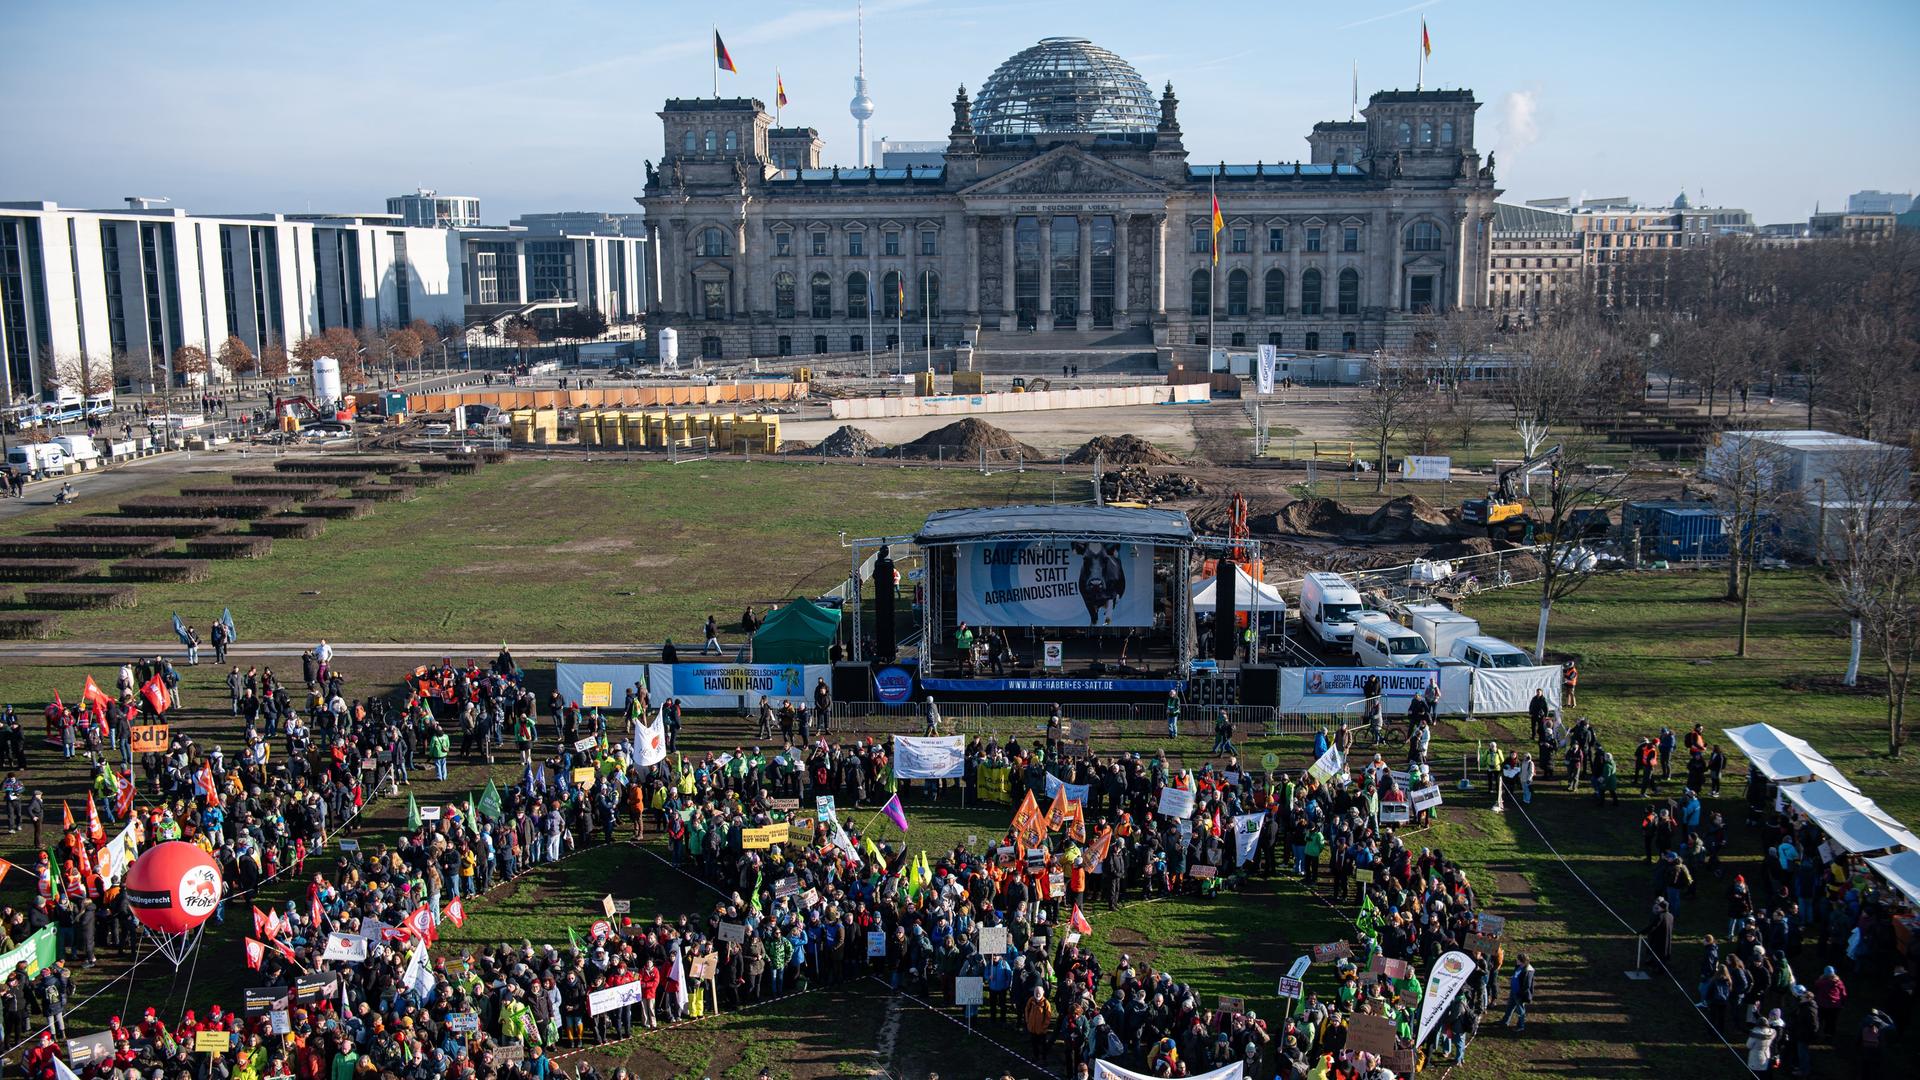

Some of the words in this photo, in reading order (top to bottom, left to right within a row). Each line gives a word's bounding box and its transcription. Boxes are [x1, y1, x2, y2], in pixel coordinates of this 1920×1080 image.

[983, 545, 1070, 566] BAUERNHÖFE
[1034, 567, 1068, 582] STATT
[985, 583, 1079, 605] AGRARINDUSTRIE!
[692, 667, 740, 677] LANDWIRTSCHAFT
[744, 667, 784, 677] GESELLSCHAFT
[1333, 674, 1352, 682] SOZIAL
[704, 677, 732, 691] HAND
[733, 677, 743, 691] IN
[745, 677, 773, 691] HAND
[1324, 681, 1352, 689] GERECHTE
